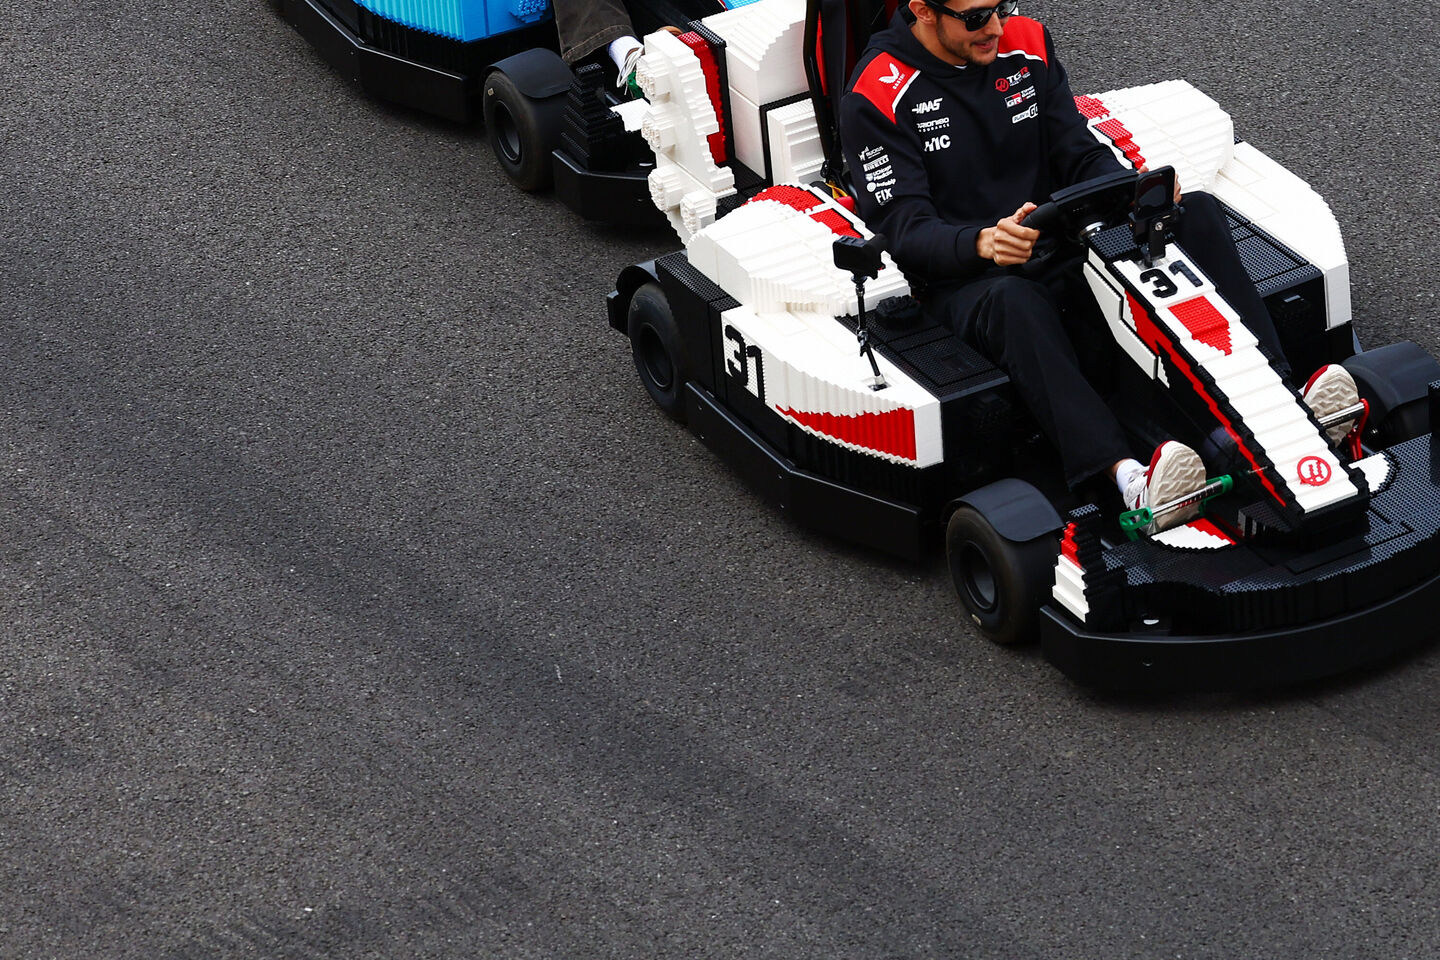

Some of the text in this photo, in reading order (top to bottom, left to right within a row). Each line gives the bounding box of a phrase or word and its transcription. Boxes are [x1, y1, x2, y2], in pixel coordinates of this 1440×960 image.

[1006, 66, 1029, 83] TGR
[875, 188, 894, 204] FIX
[1139, 259, 1204, 299] 31
[725, 324, 767, 405] 31
